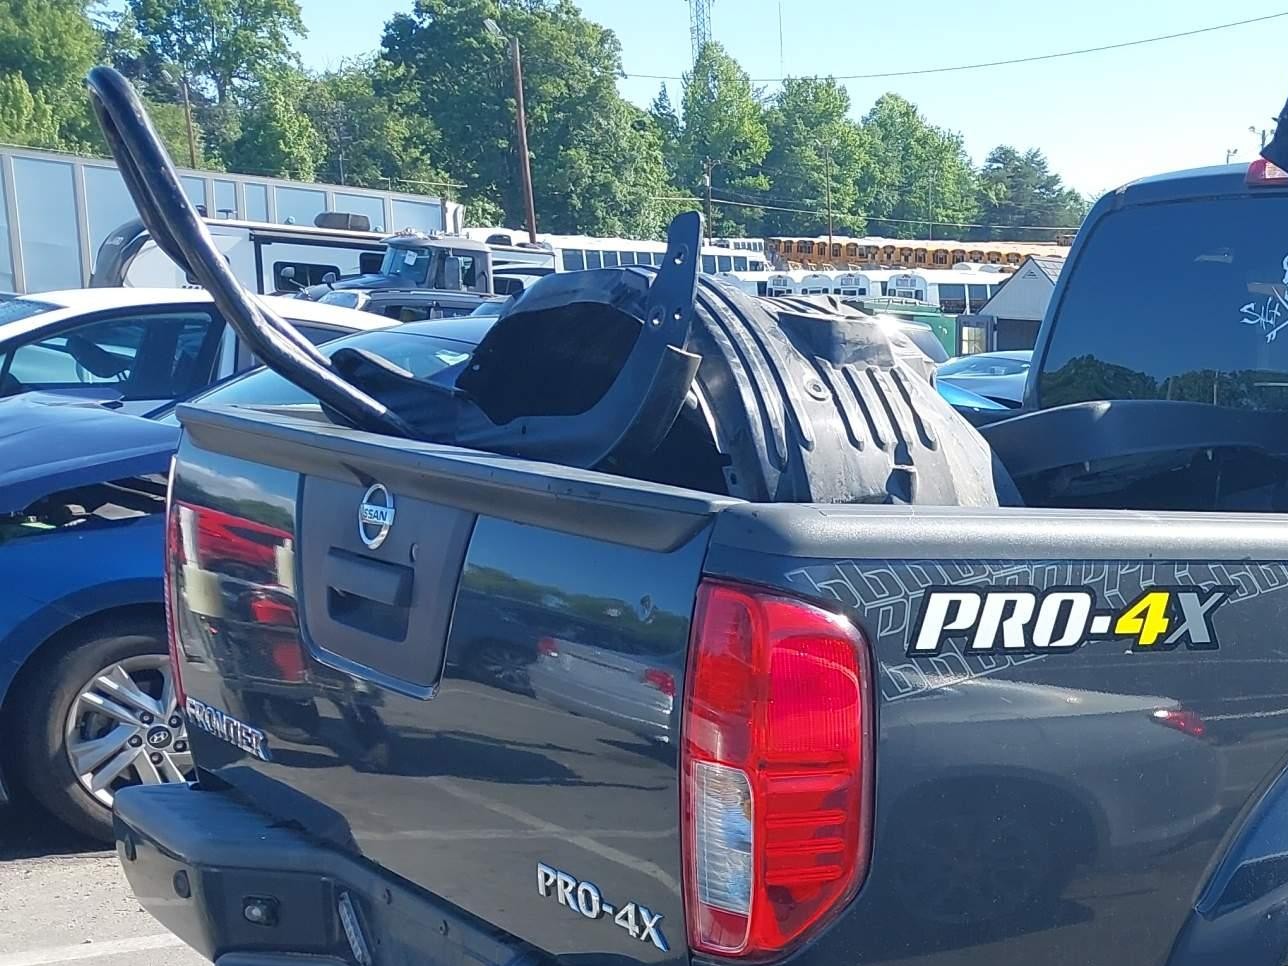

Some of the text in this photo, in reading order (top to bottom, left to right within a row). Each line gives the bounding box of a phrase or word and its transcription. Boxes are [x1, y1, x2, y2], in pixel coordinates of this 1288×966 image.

[914, 590, 1226, 650] PRO-4X
[186, 696, 271, 761] FRONTIER
[536, 861, 671, 952] PRO-4X
